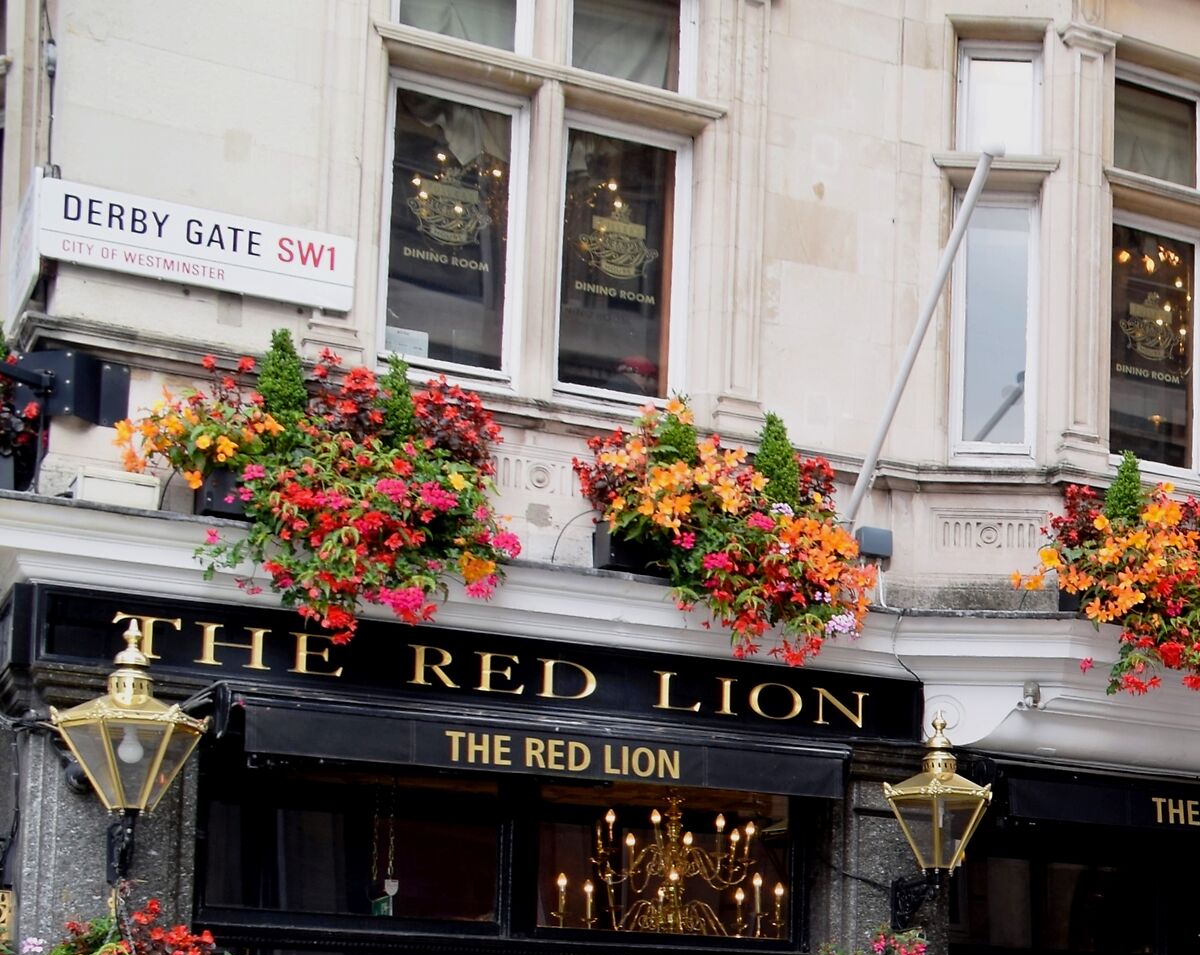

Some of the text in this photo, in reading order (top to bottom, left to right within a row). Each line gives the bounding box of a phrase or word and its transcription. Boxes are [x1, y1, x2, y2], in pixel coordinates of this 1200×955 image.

[63, 193, 335, 271] DERBY GATE SW1
[61, 239, 225, 281] CITY OF WESTMINSTER
[403, 246, 489, 272] DINING ROOM
[575, 280, 656, 305] DINING ROOM
[1116, 363, 1180, 385] DINING ROOM
[112, 611, 869, 729] THE RED LION
[445, 730, 680, 779] THE RED LION
[1152, 797, 1200, 826] THE
